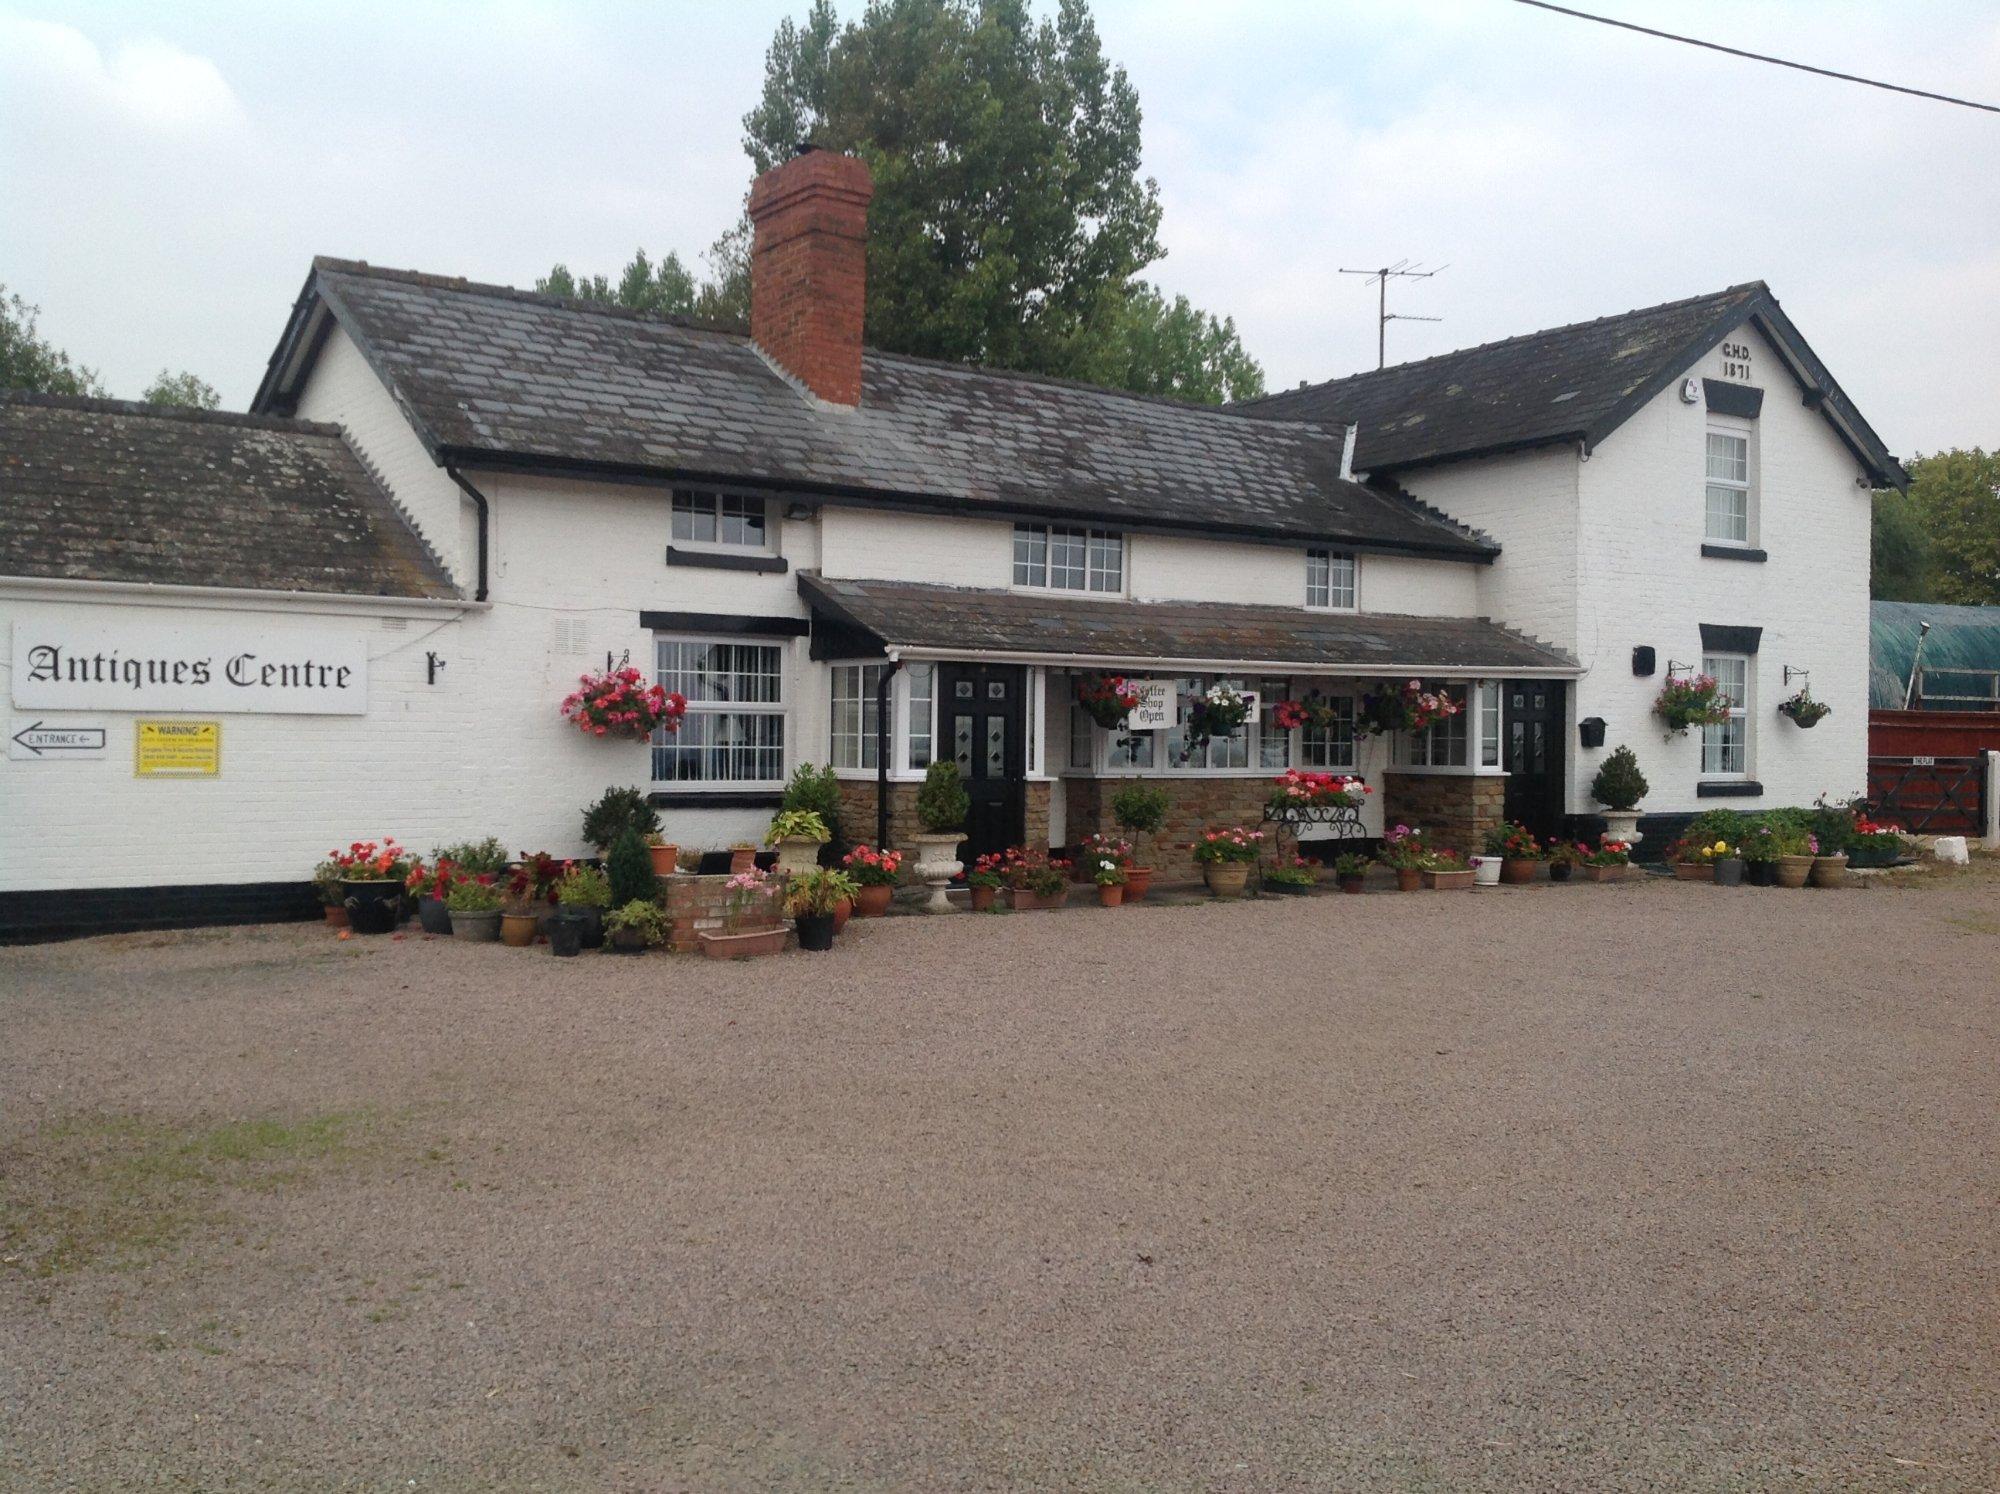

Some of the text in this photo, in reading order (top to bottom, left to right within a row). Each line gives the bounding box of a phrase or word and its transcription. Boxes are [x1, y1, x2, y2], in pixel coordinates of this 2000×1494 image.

[1724, 362, 1750, 380] 1871
[27, 644, 352, 691] Antiques Centre
[1140, 697, 1164, 711] Shop
[1139, 709, 1165, 724] Open
[28, 734, 78, 744] ENTRANCE
